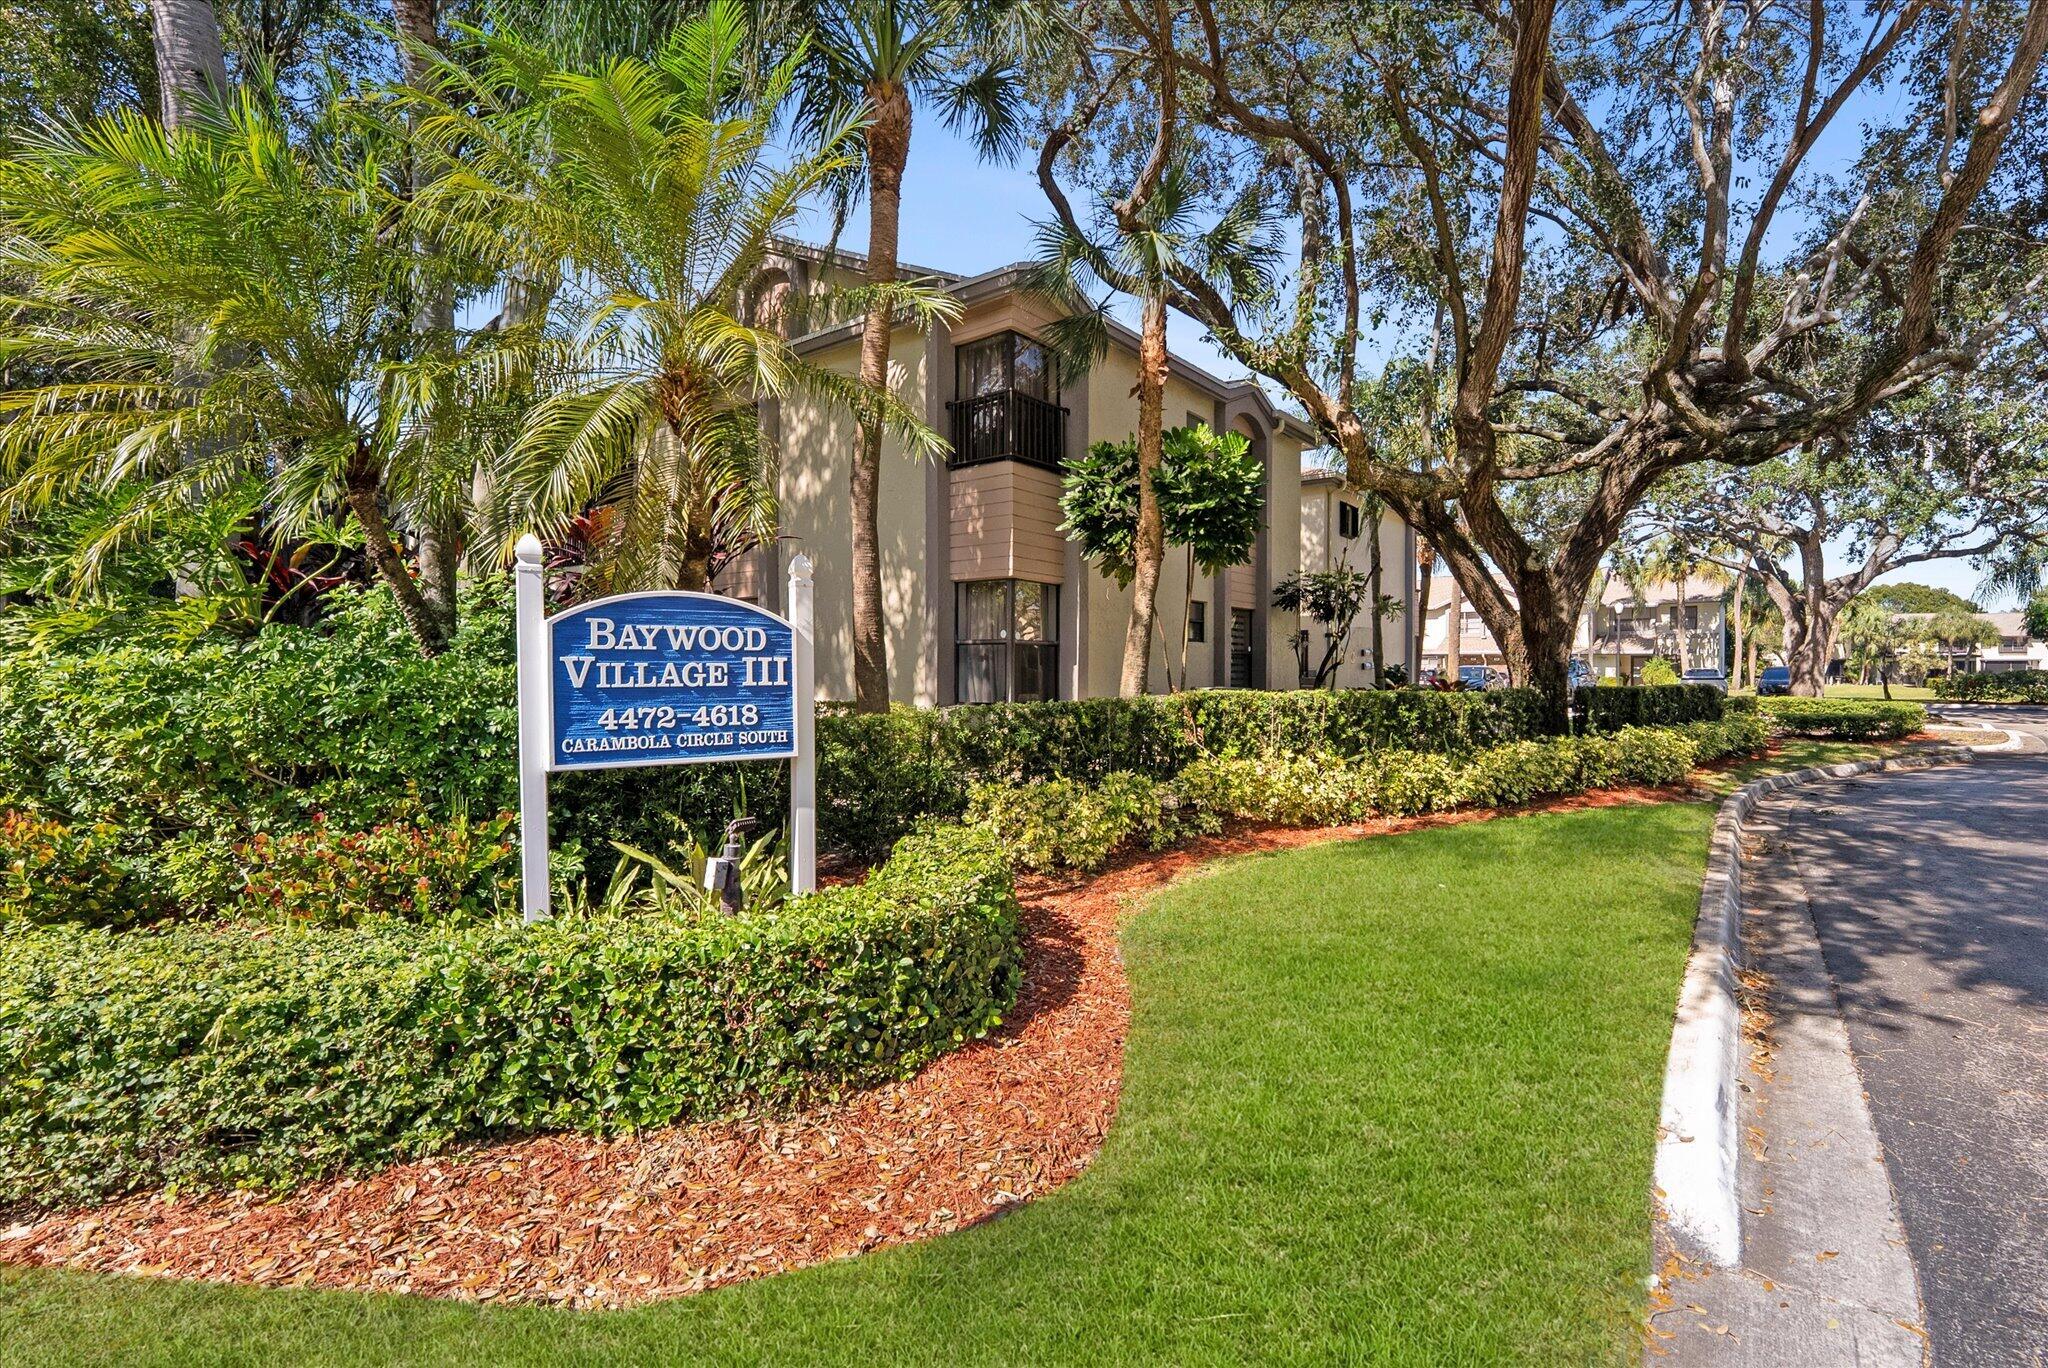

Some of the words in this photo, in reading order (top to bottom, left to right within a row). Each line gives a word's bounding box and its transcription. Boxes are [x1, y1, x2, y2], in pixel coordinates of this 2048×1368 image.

[585, 618, 766, 651] BAYWOOD
[560, 655, 728, 689] VILLAGE
[742, 656, 788, 686] III
[561, 735, 670, 753] CARAMBOLA
[676, 733, 733, 747] CIRCLE
[739, 730, 788, 745] SOUTH
